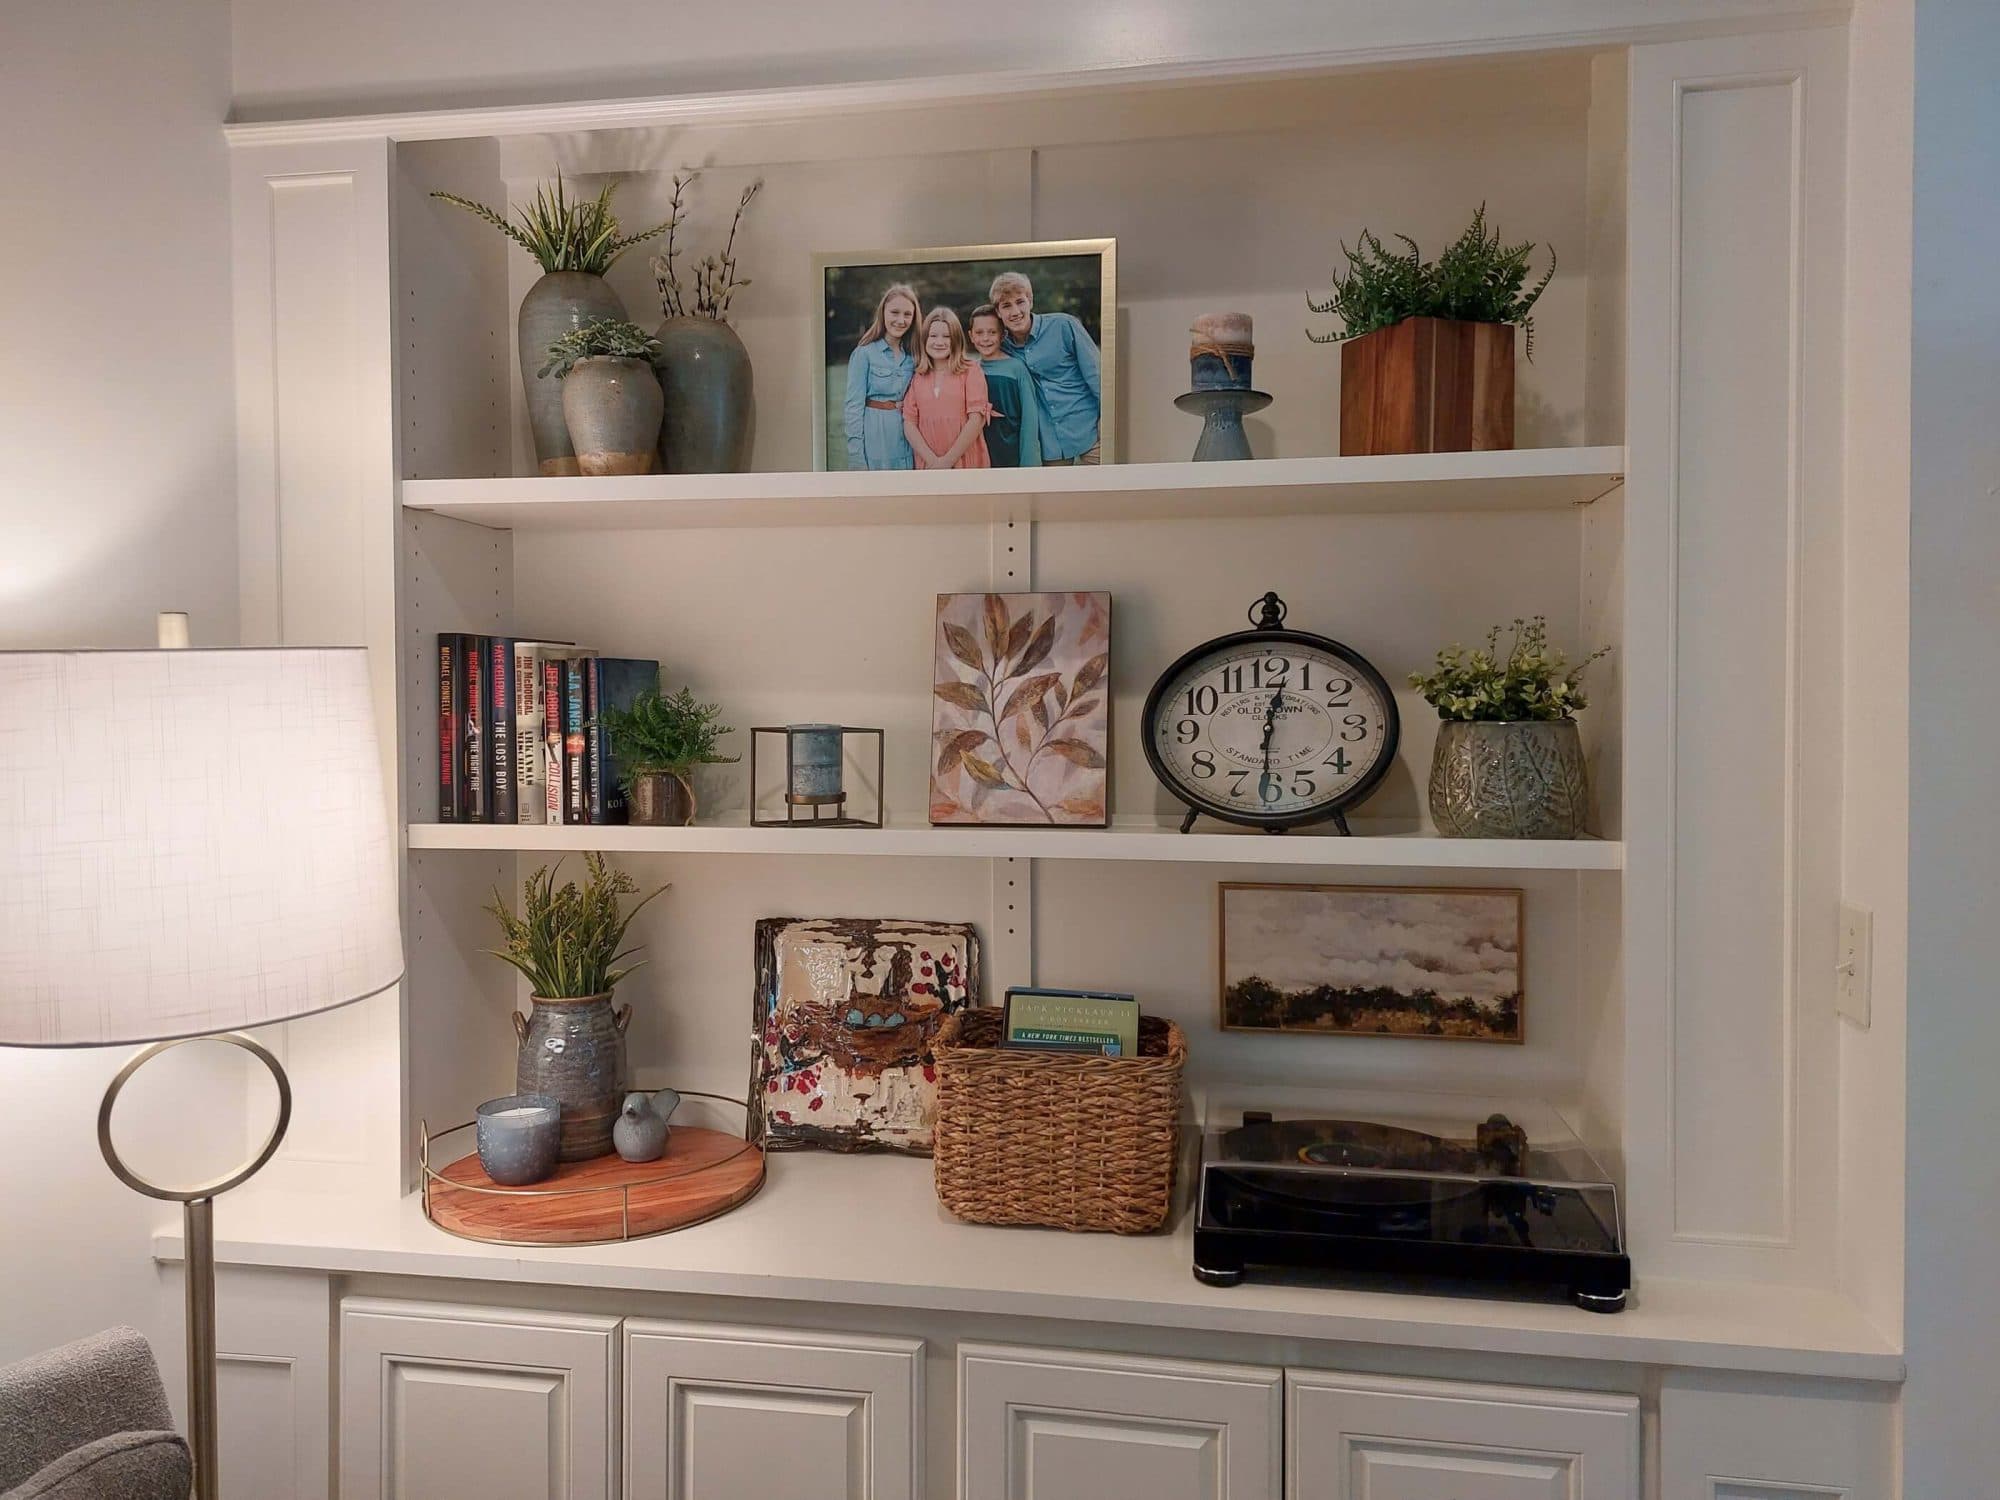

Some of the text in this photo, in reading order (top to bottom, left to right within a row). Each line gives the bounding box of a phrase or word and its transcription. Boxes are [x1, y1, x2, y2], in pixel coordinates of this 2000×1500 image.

[468, 651, 479, 681] MICHAEL
[494, 644, 505, 708] FAYE KELLERMAN
[1219, 665, 1244, 694] 11
[1248, 657, 1291, 689] 12
[1299, 662, 1315, 691] 1
[440, 646, 451, 717] MICHAEL CONNELLY
[523, 655, 533, 716] JIM McDOUGAL
[1325, 678, 1353, 708] 2
[545, 664, 559, 730] JEFF ABBOTT
[568, 671, 581, 733] J.A. JANCE
[1183, 685, 1219, 716] 10
[1237, 707, 1262, 715] OLD
[1176, 719, 1200, 744] 9
[1340, 714, 1368, 742] 3
[441, 753, 452, 785] WARNING
[470, 740, 480, 792] THE NIGHT FIRE
[495, 720, 507, 796] THE LOST BOYS
[590, 740, 600, 775] NEVER
[1190, 750, 1217, 779] 8
[1225, 745, 1314, 765] STANDARD TIME
[1321, 746, 1353, 775] 4
[547, 760, 560, 811] COLLISION
[571, 756, 580, 809] TRIAL BY FIRE
[590, 777, 599, 800] LIST
[1225, 770, 1251, 797] 7
[1257, 771, 1283, 803] 6
[1290, 769, 1317, 797] 5
[1042, 1033, 1057, 1041] YORK
[1059, 1034, 1077, 1042] TIMES
[1078, 1036, 1115, 1044] BESTSELLER
